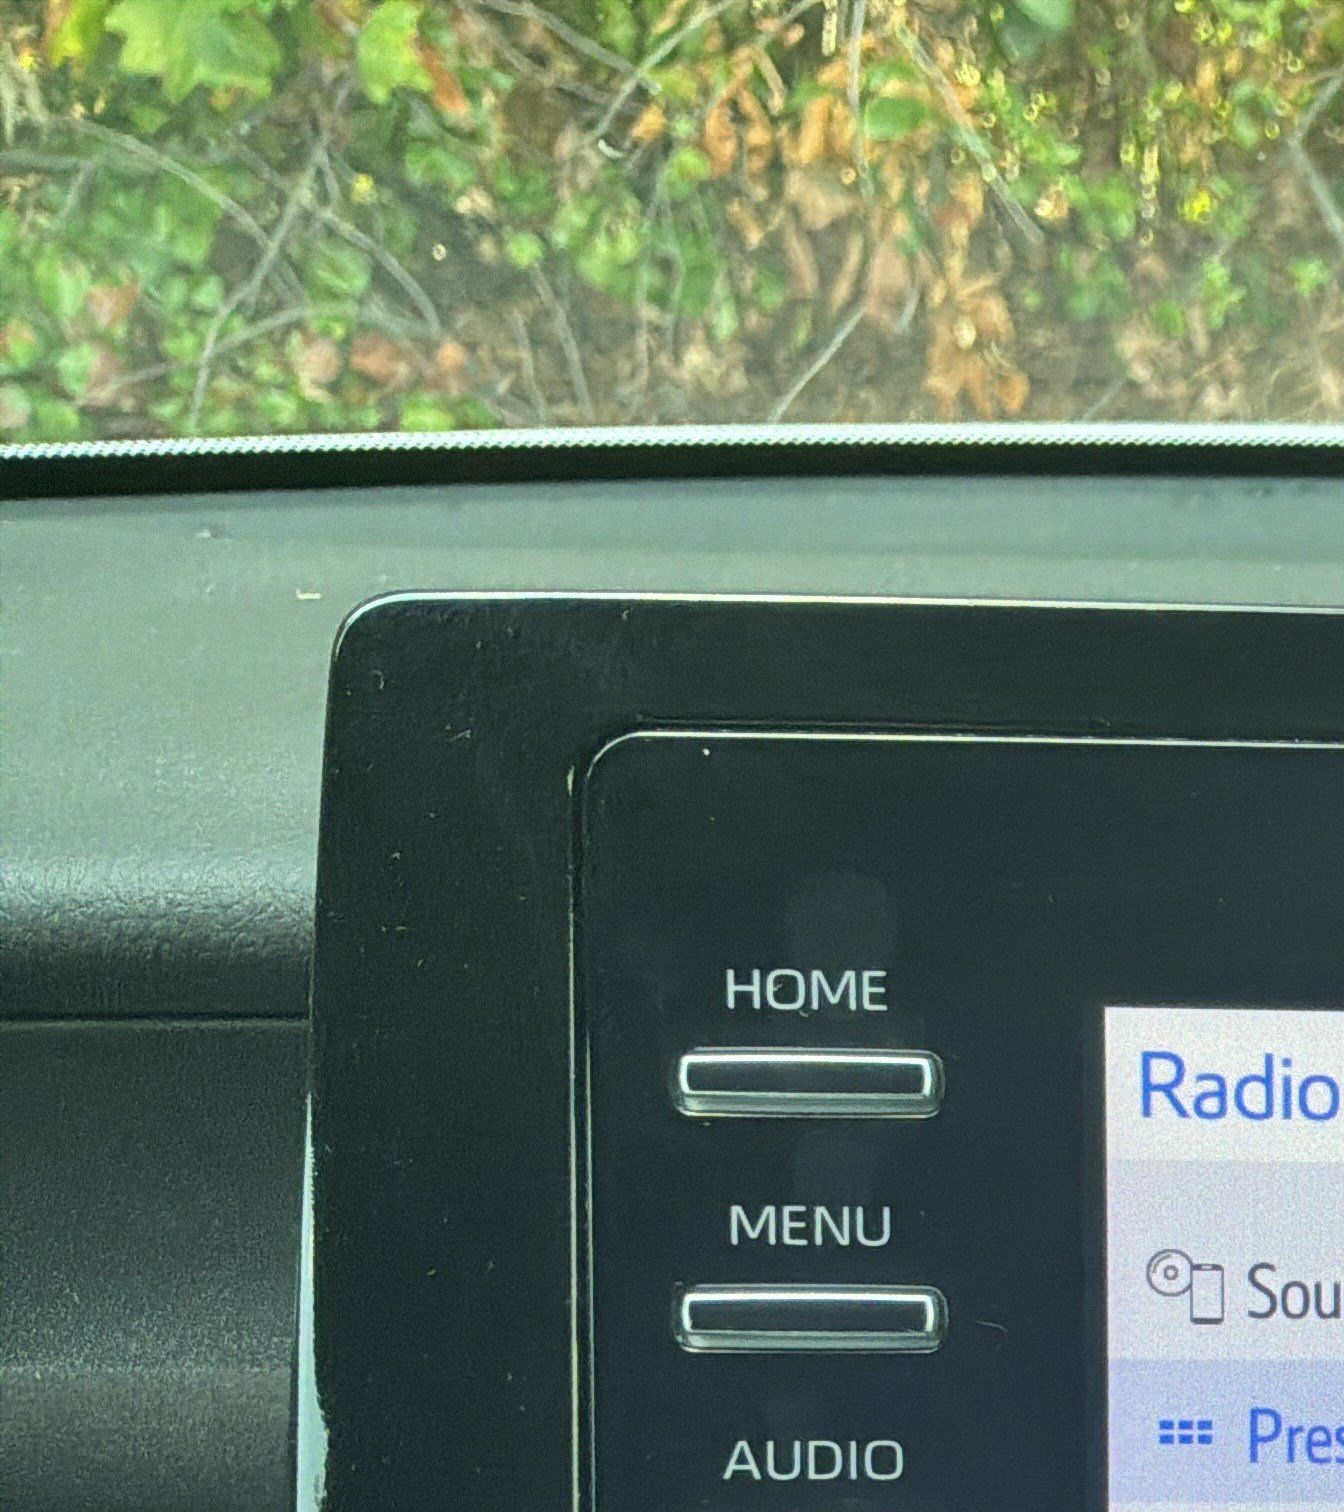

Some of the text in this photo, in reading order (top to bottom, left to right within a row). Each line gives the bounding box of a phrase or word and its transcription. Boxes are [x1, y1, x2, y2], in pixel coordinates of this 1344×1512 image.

[727, 969, 887, 1010] HOME
[1141, 1051, 1339, 1121] Radio
[731, 1205, 890, 1246] MENU
[724, 1440, 903, 1480] AUDIO
